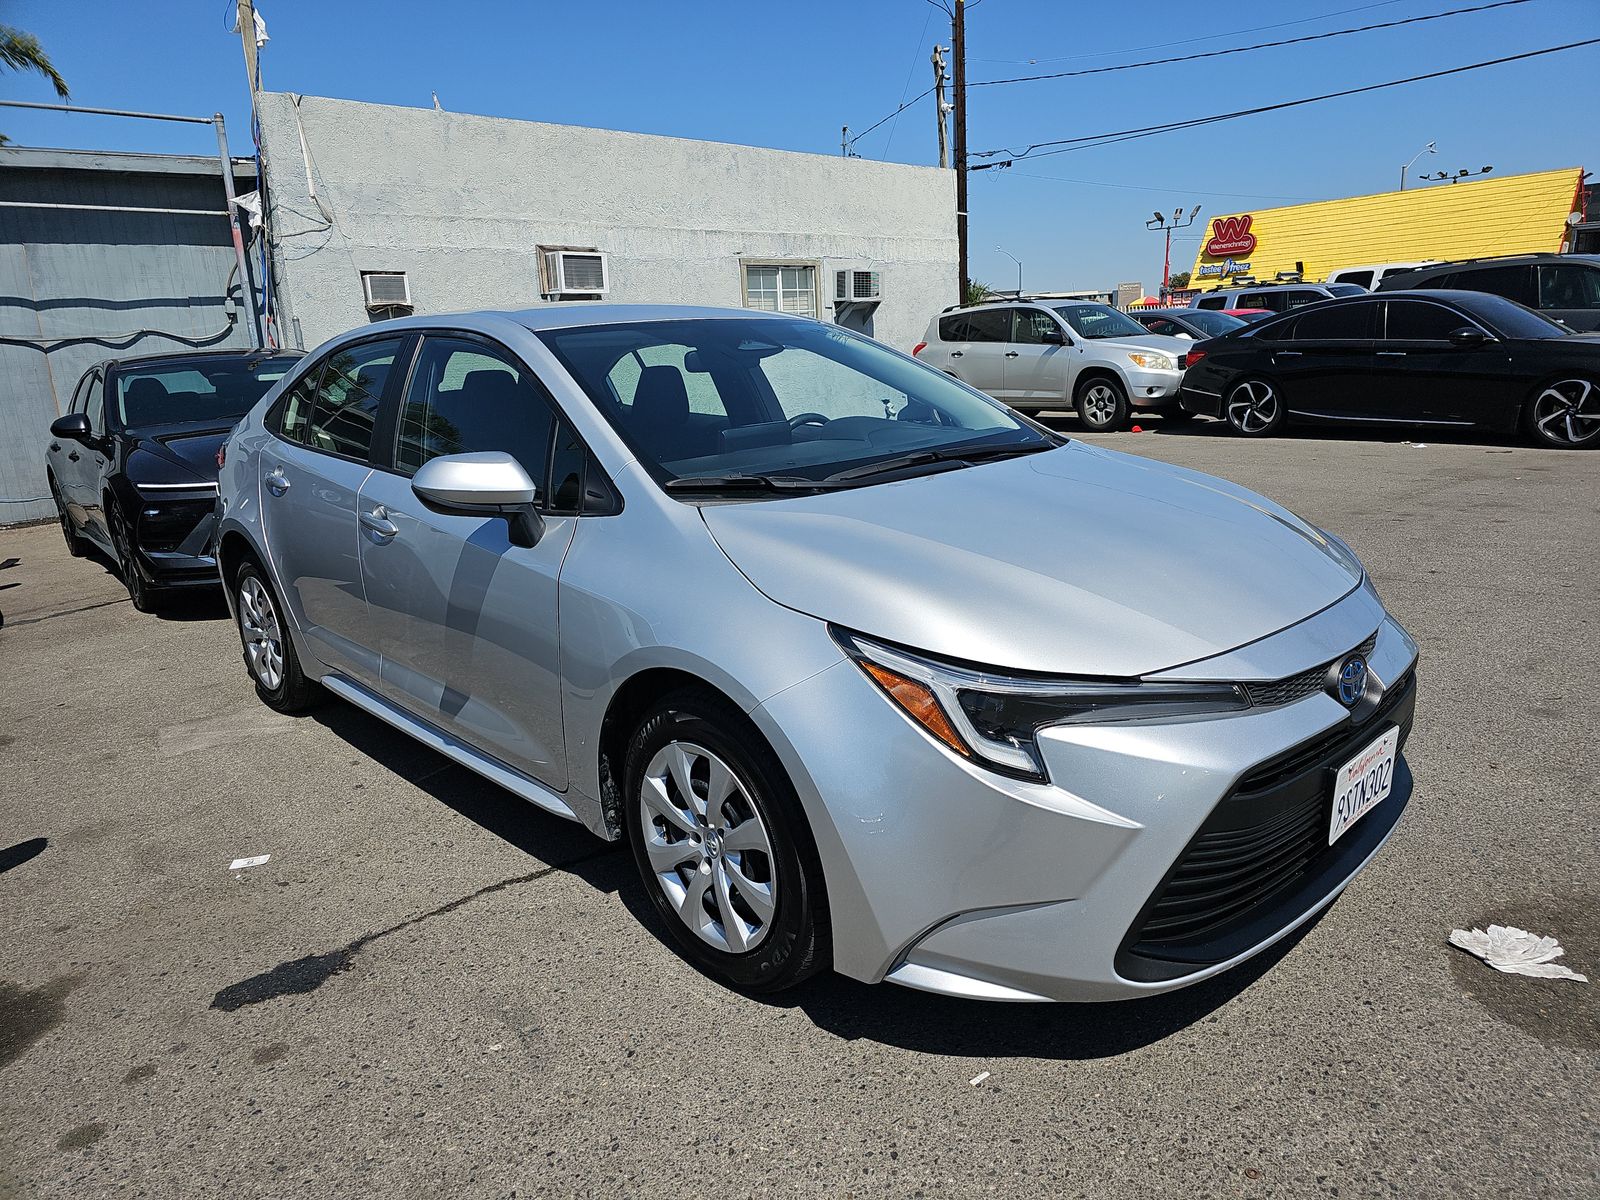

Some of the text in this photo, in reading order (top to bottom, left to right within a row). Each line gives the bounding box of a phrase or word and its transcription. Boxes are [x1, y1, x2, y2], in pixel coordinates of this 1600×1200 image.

[1213, 216, 1250, 242] W
[1229, 262, 1250, 272] freez
[1334, 757, 1392, 834] 9STN302
